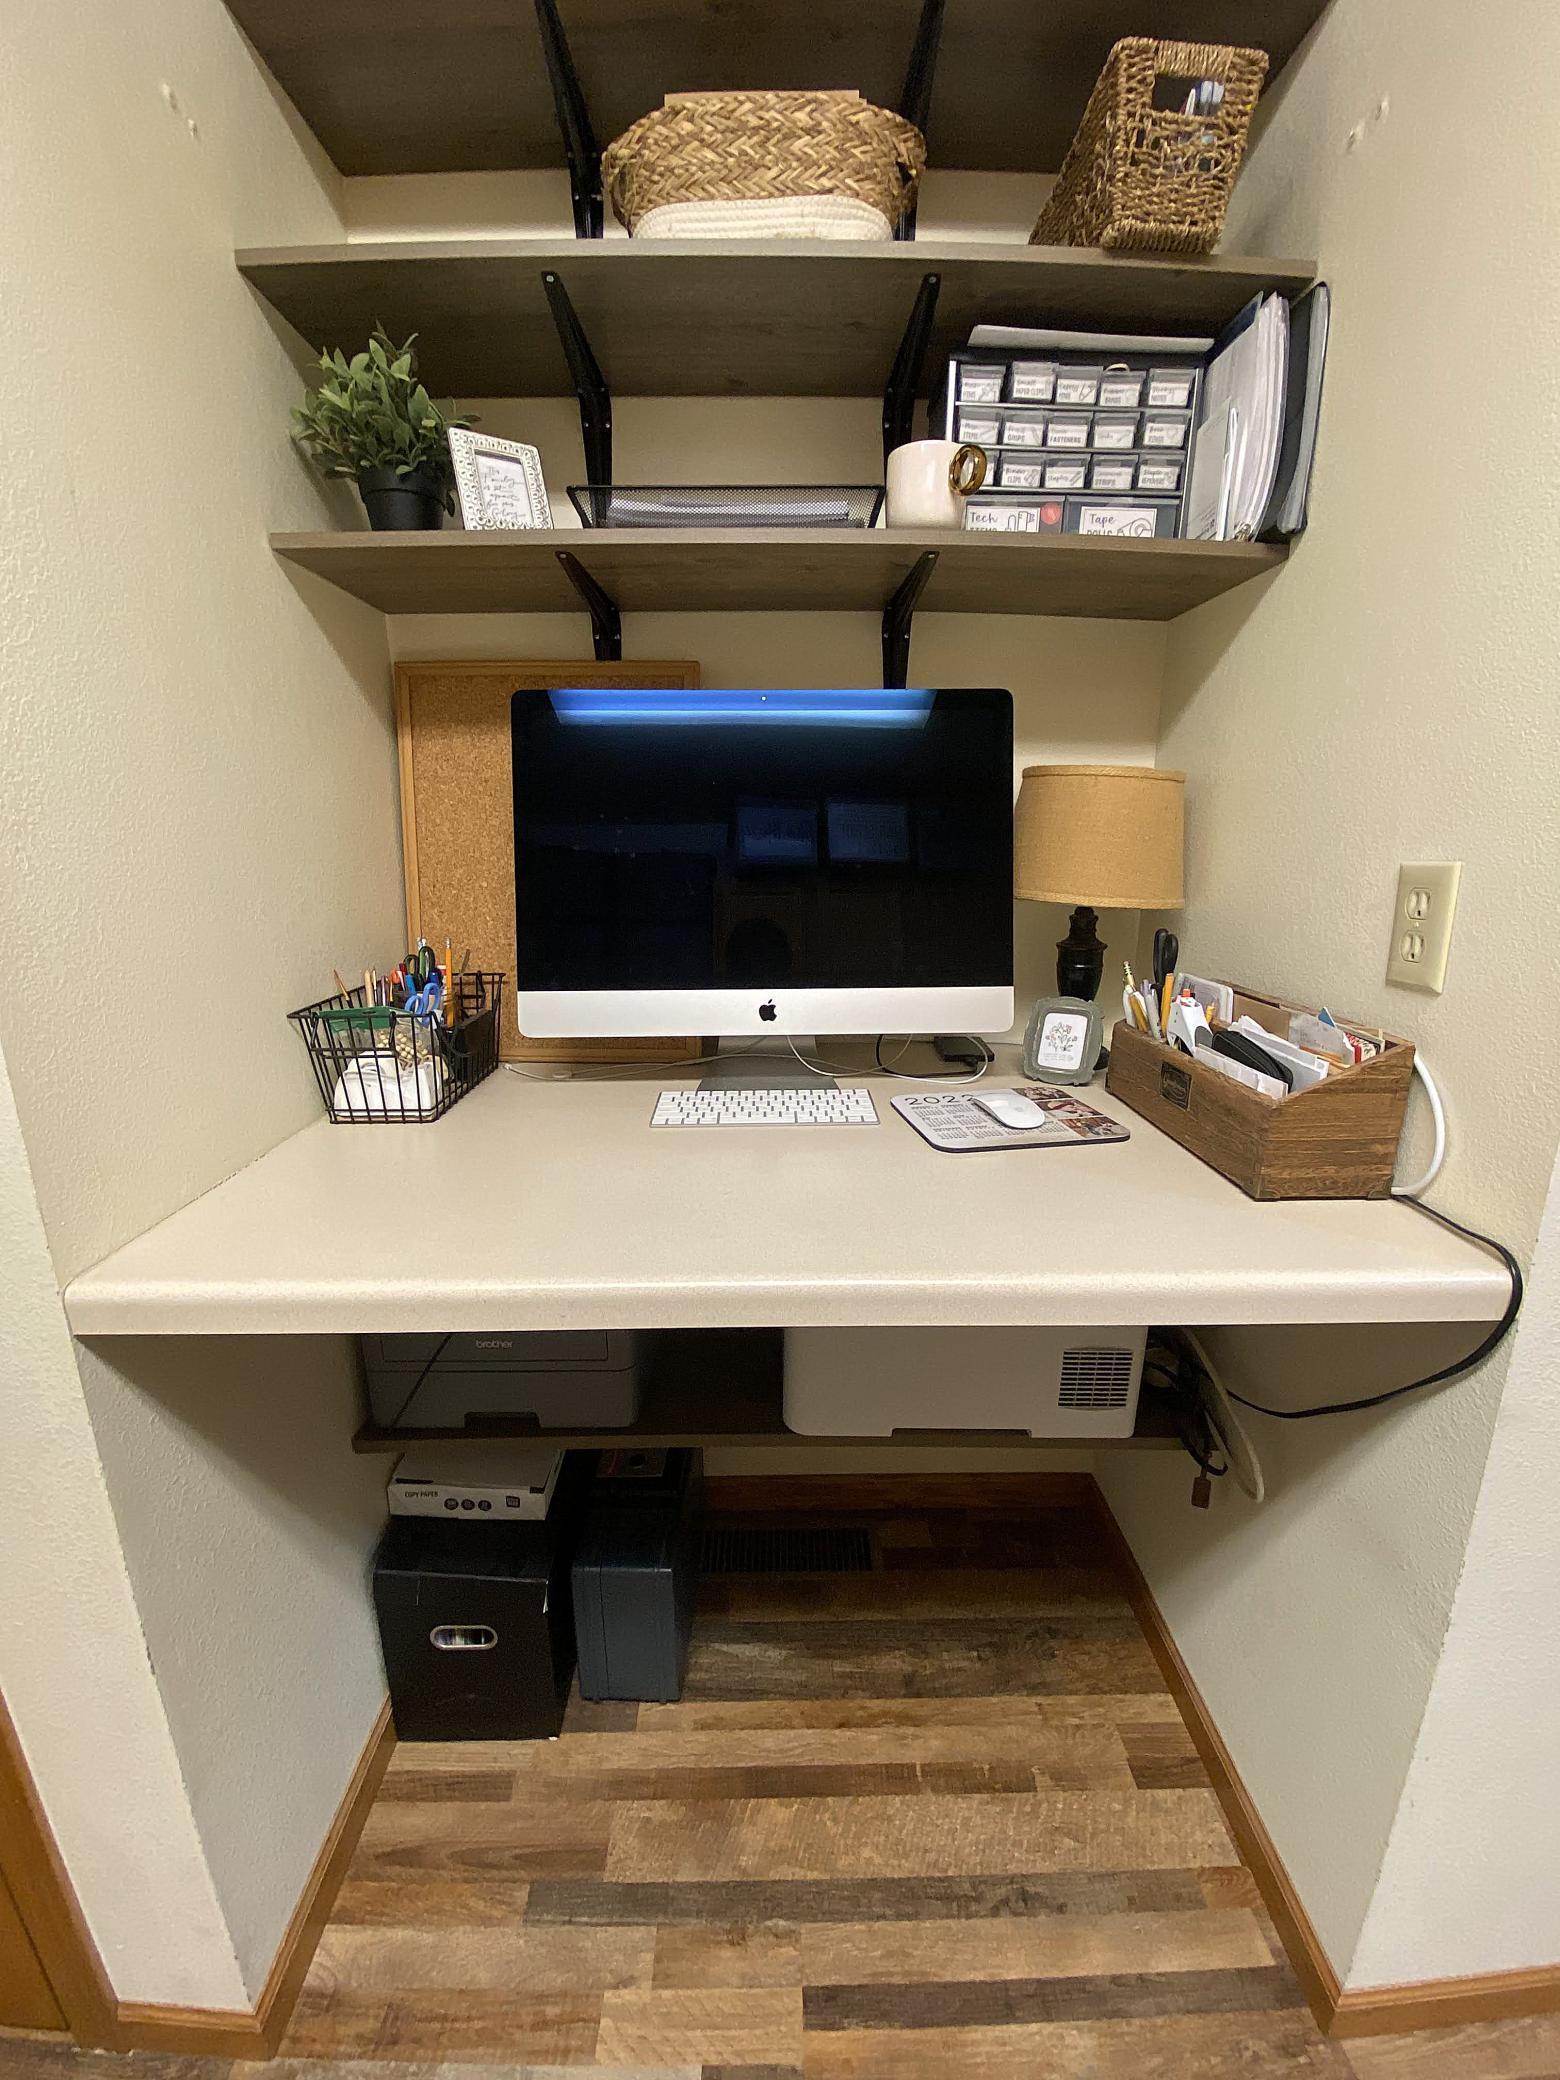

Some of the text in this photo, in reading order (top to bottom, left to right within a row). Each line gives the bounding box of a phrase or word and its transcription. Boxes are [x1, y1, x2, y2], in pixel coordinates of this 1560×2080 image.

[970, 511, 999, 524] Tech
[1090, 513, 1117, 528] Tape
[475, 1339, 513, 1349] brother
[404, 1490, 439, 1499] COPY PAPER
